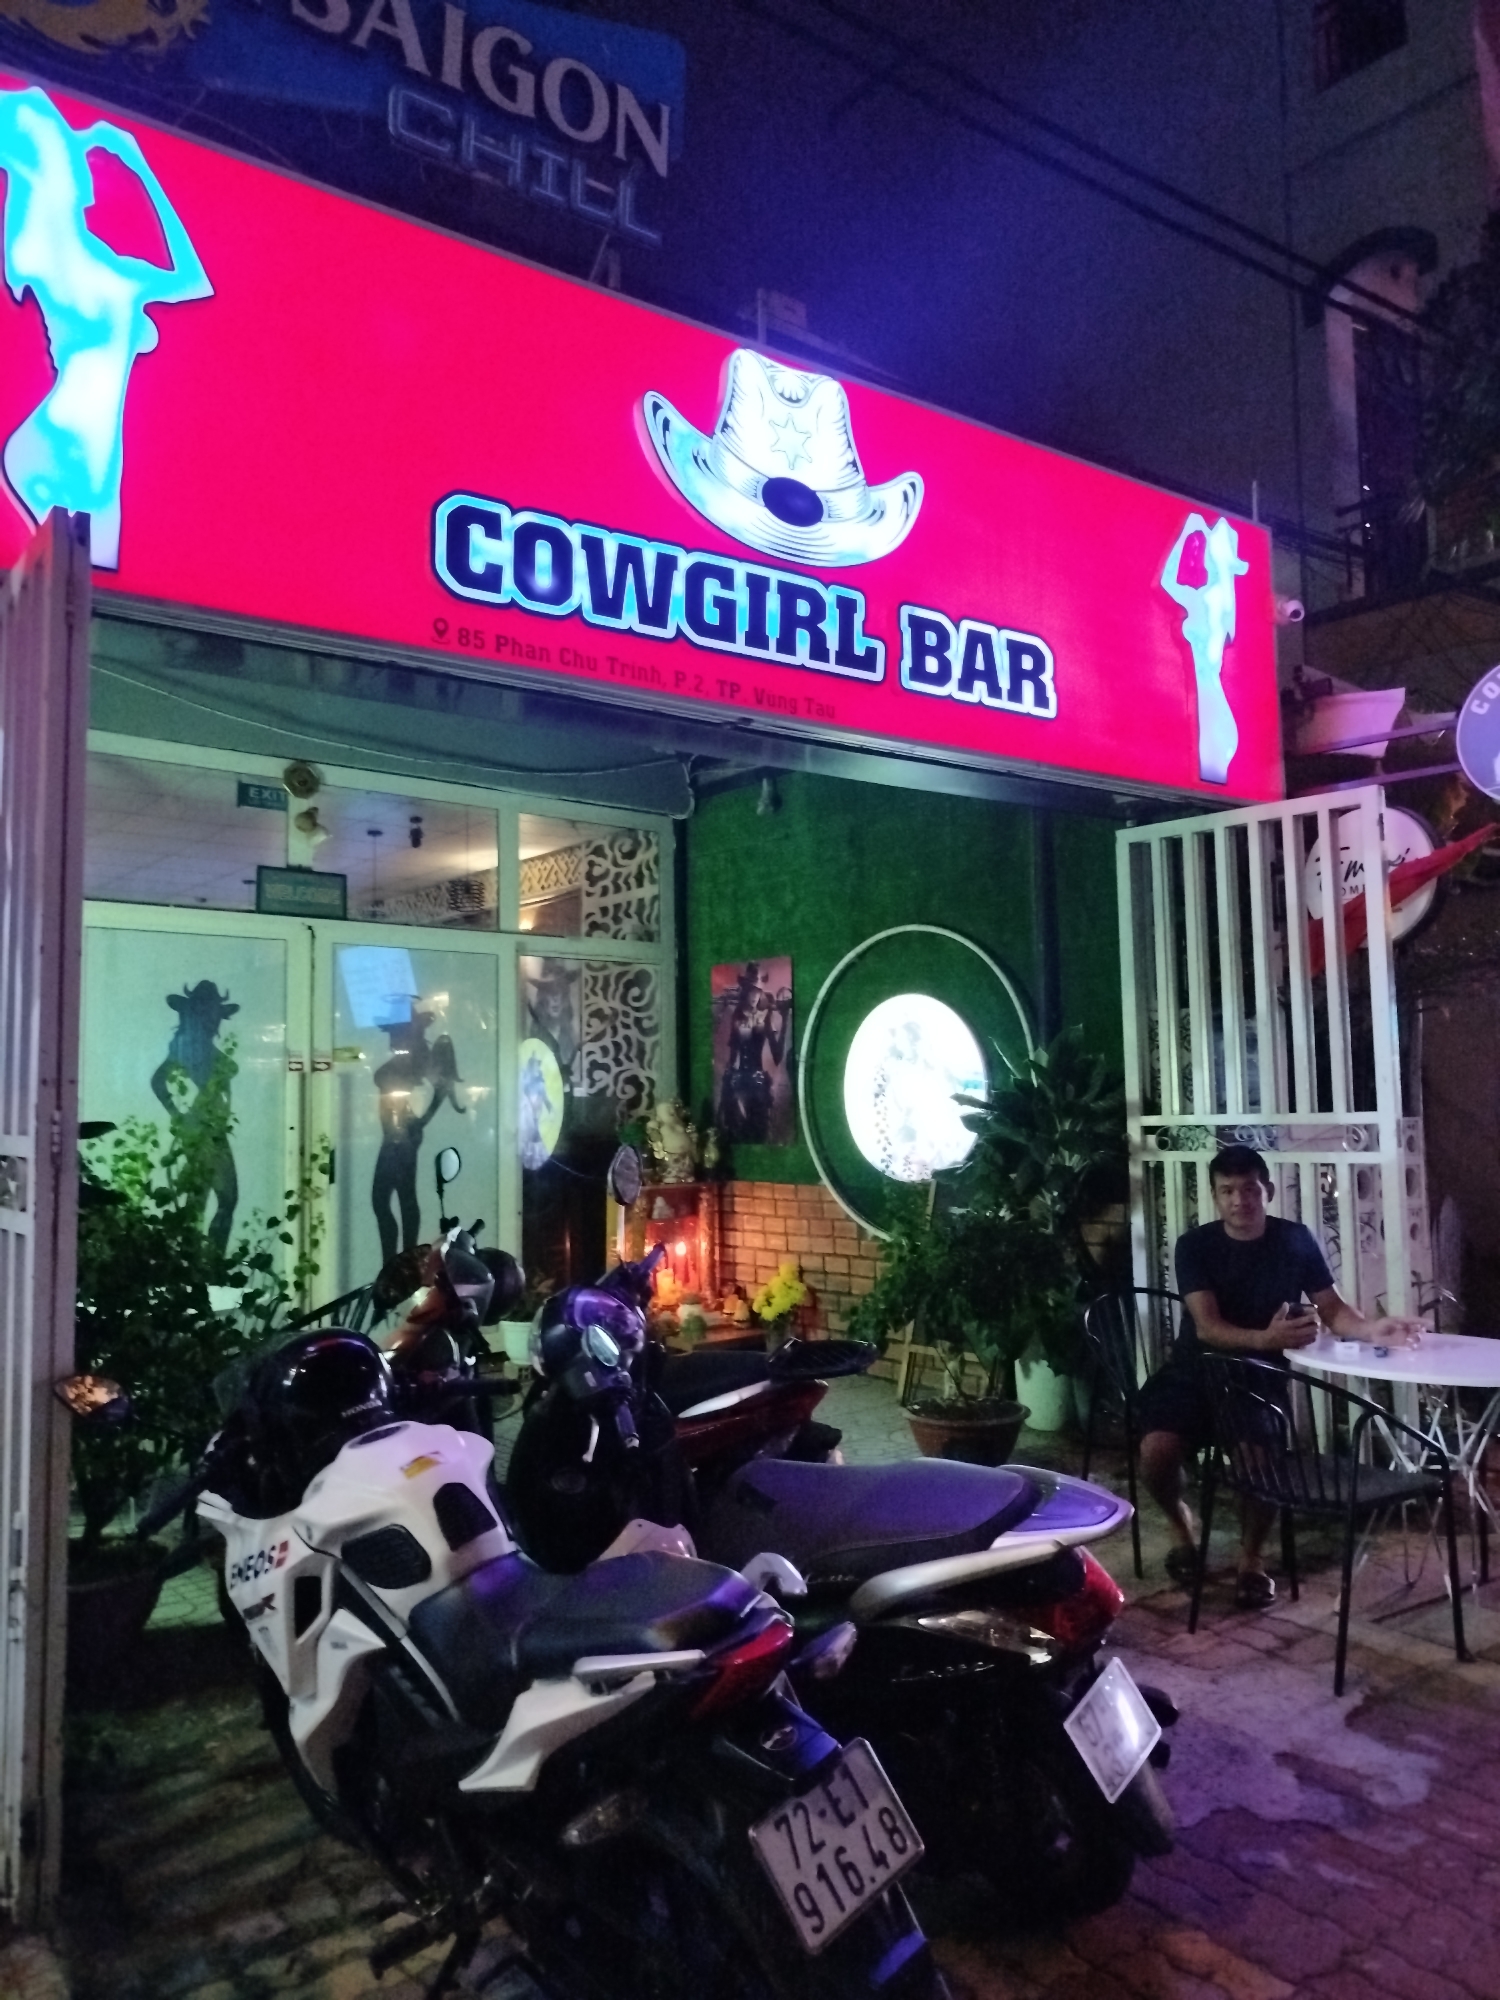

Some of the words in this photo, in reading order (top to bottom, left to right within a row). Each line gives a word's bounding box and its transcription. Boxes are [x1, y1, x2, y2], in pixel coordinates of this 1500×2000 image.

[388, 83, 662, 247] CHILL
[437, 496, 885, 681] COWGIRL
[902, 607, 1056, 717] BAR
[457, 626, 486, 650] 85
[495, 634, 551, 663] Phan
[559, 647, 598, 672] Chu
[793, 1806, 909, 1935] 916.48
